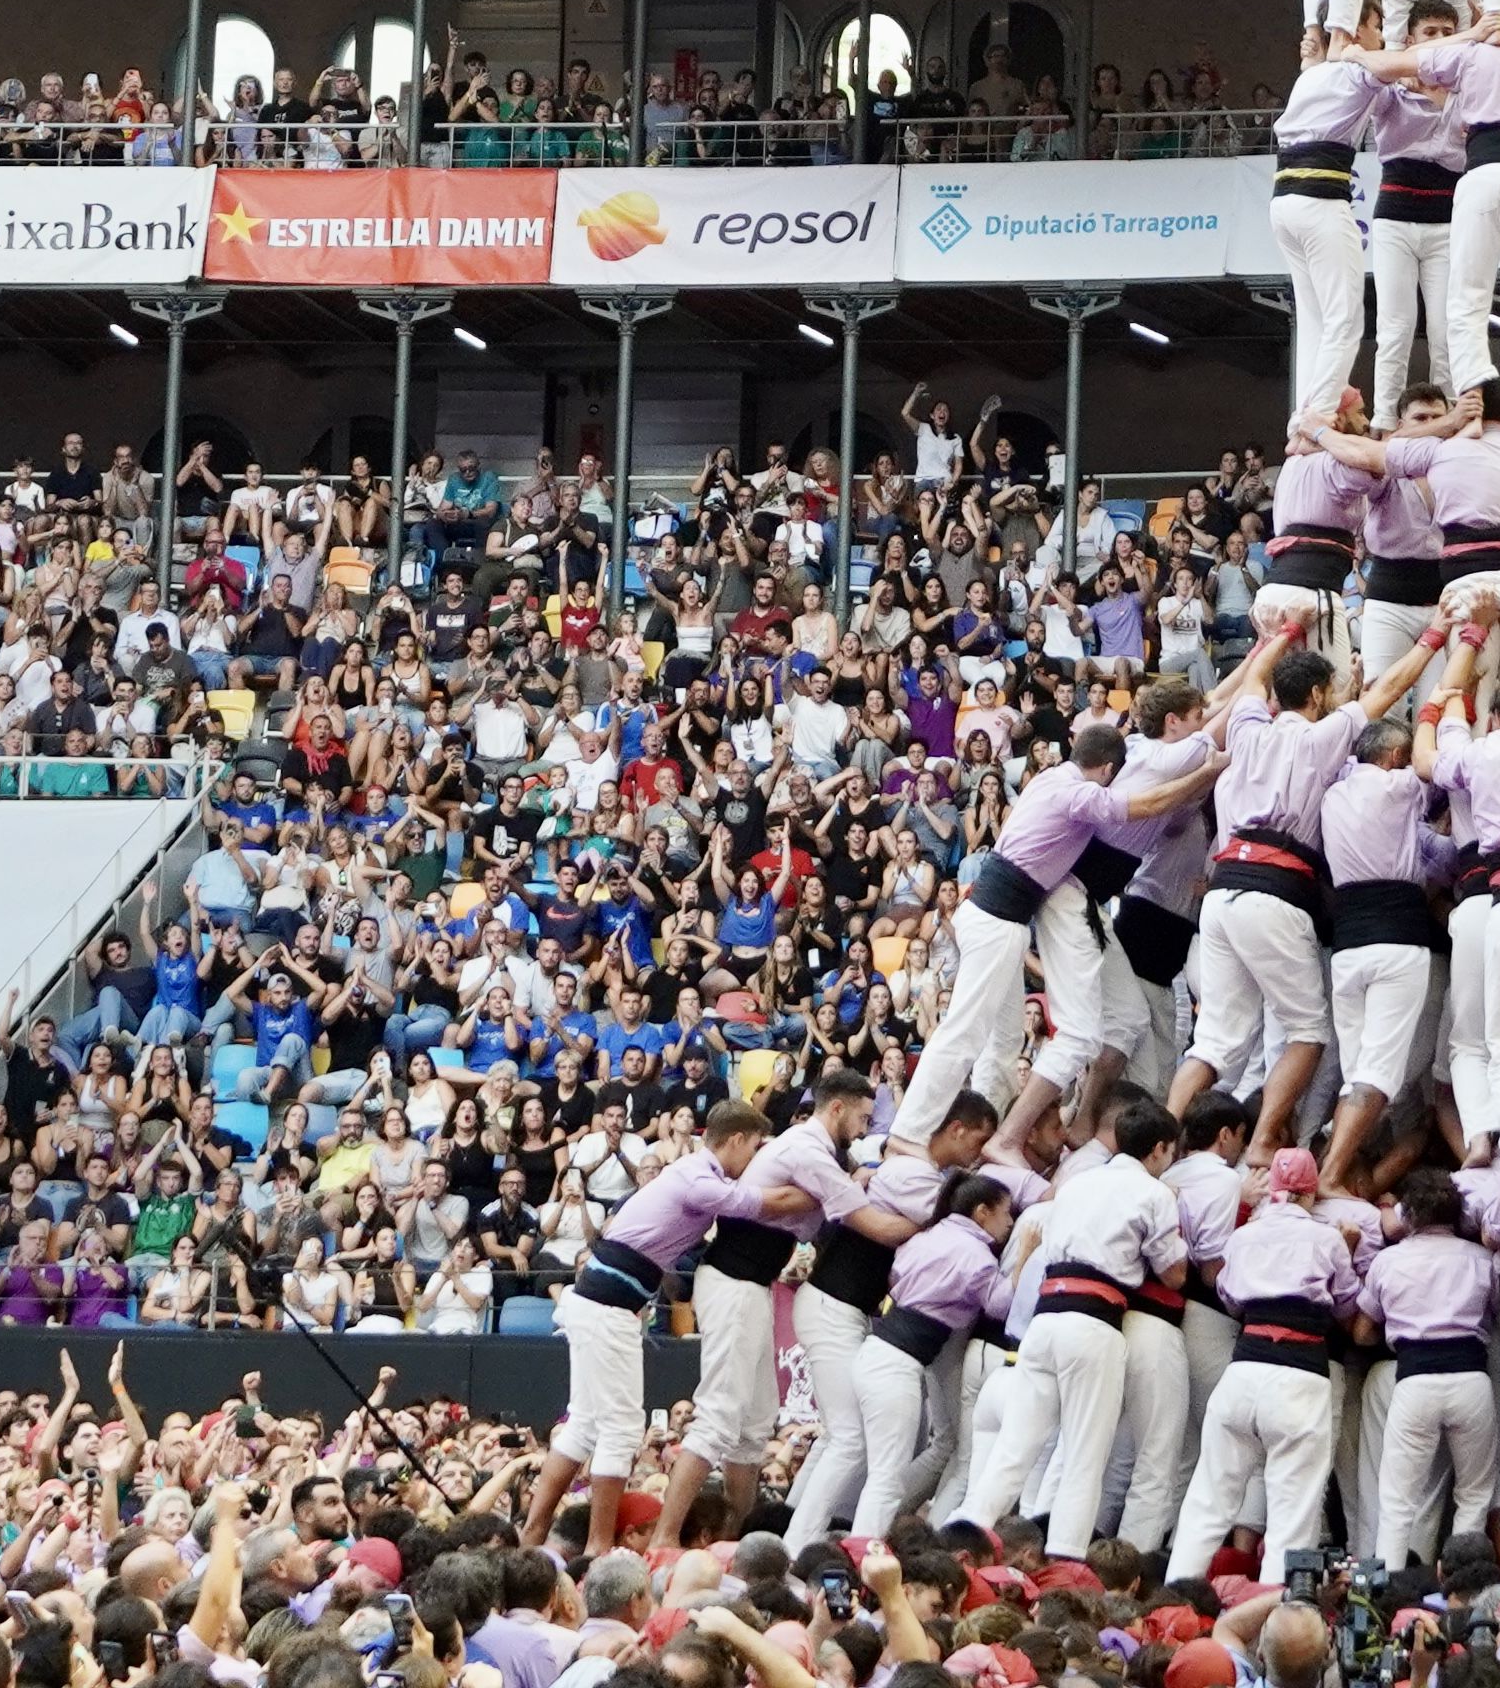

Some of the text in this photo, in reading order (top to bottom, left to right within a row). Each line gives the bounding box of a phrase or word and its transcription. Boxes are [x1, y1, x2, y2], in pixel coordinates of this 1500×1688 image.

[267, 216, 544, 249] ESTRELLA DAMM
[692, 201, 876, 253] repsol
[985, 211, 1219, 243] Diputació Tarragona
